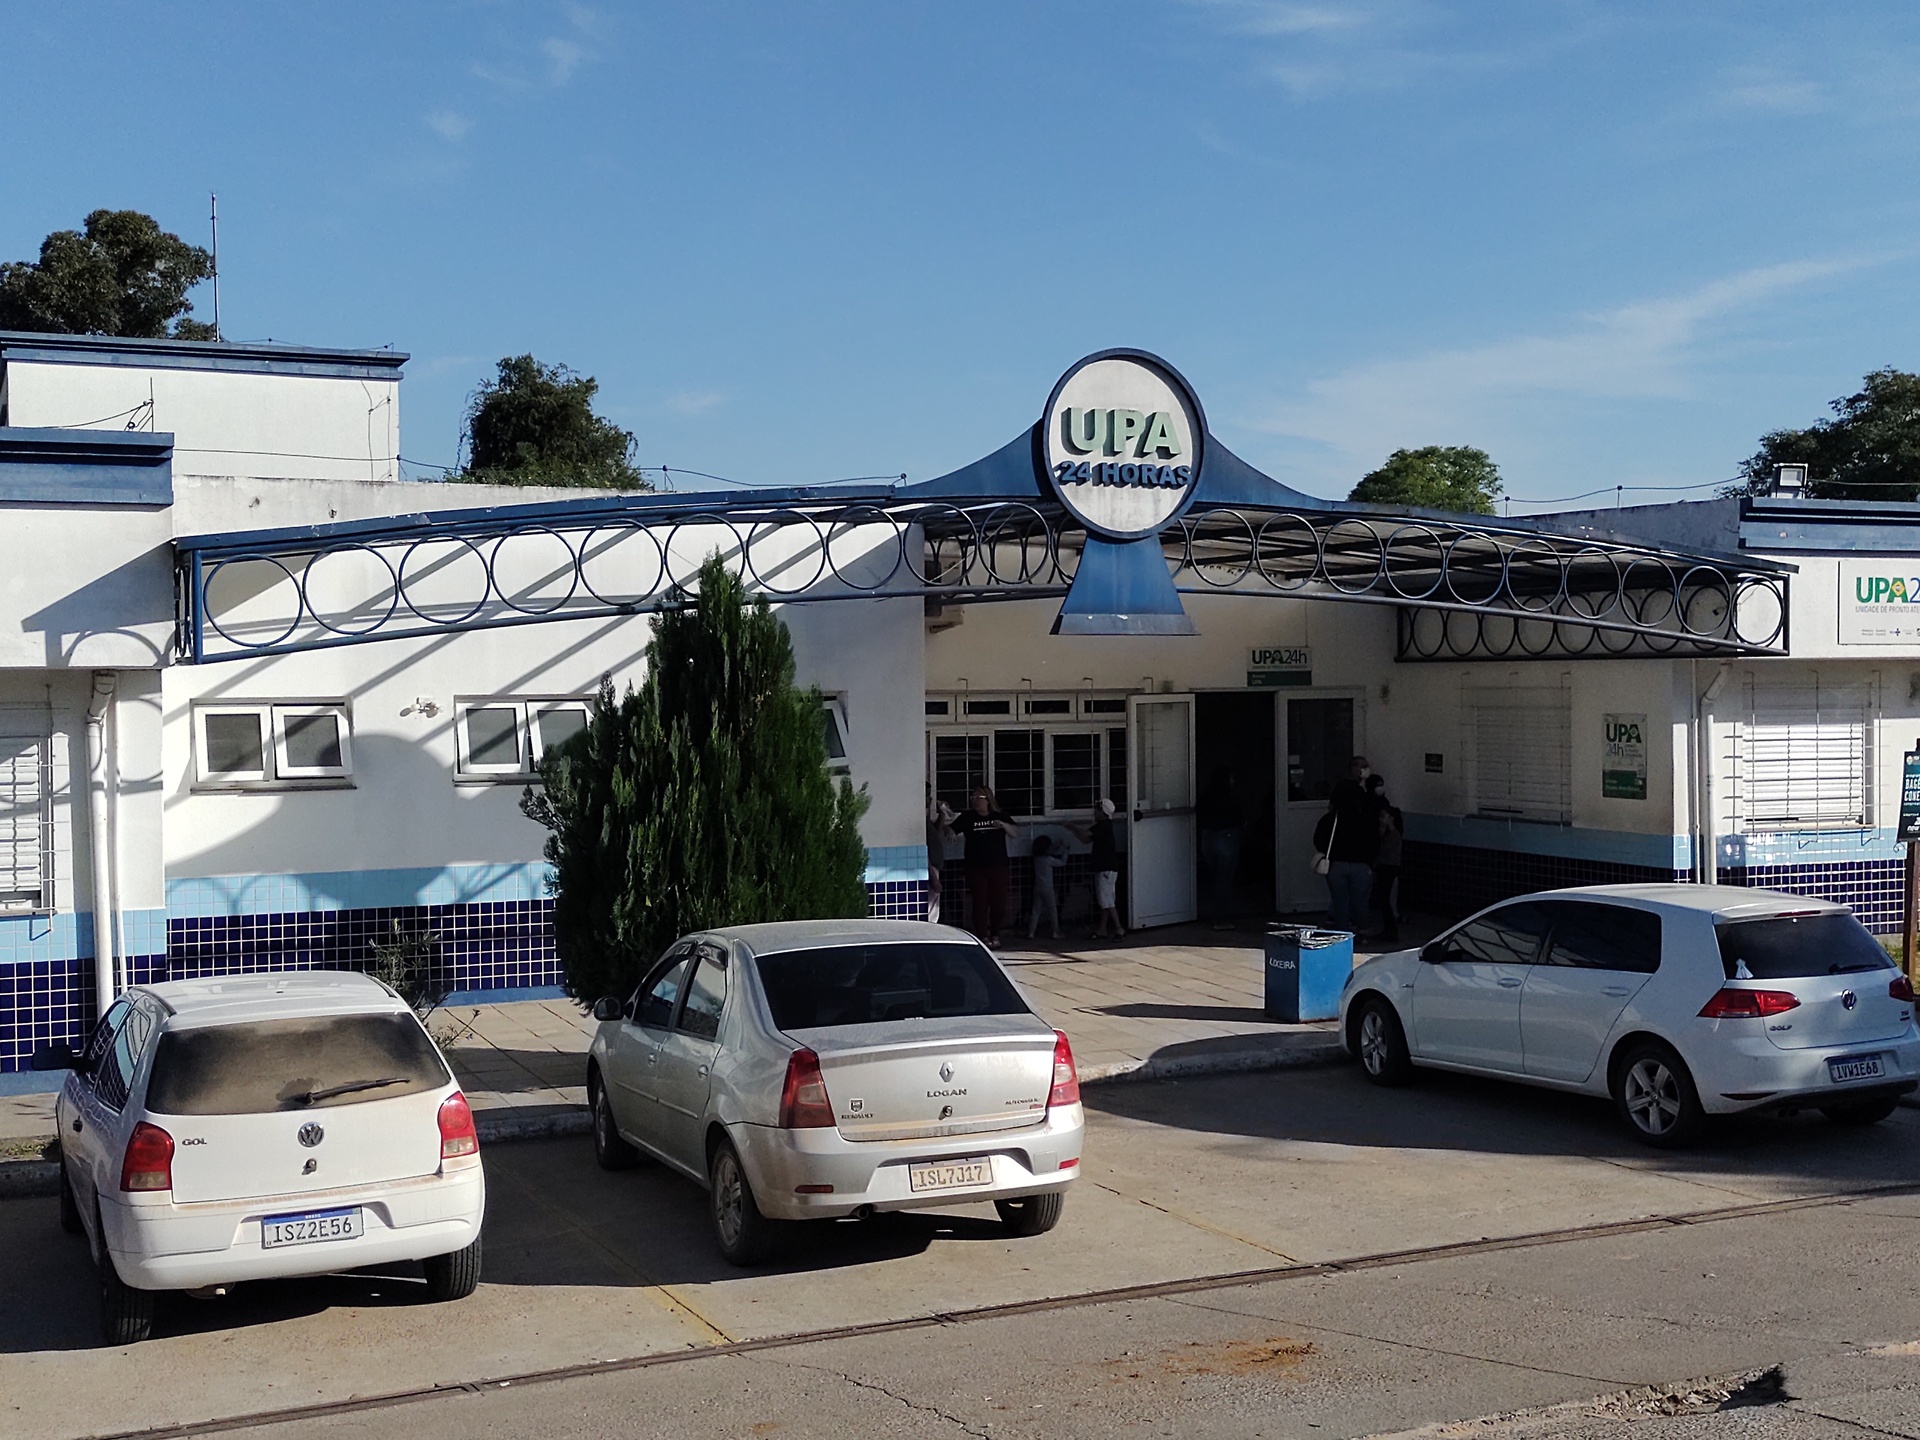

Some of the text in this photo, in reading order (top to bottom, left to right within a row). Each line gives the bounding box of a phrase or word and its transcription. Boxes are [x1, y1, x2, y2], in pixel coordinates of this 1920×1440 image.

[1061, 407, 1182, 459] UPA
[1053, 461, 1192, 489] 24 HORAS
[1880, 605, 1888, 613] DE
[1606, 723, 1642, 743] UPA
[1606, 743, 1624, 757] 24h
[1269, 957, 1296, 970] LIXEIRA
[926, 1088, 967, 1098] LOGAN
[182, 1137, 207, 1146] GOL
[918, 1165, 983, 1188] ISL7J17
[273, 1217, 352, 1243] ISZ2E56
